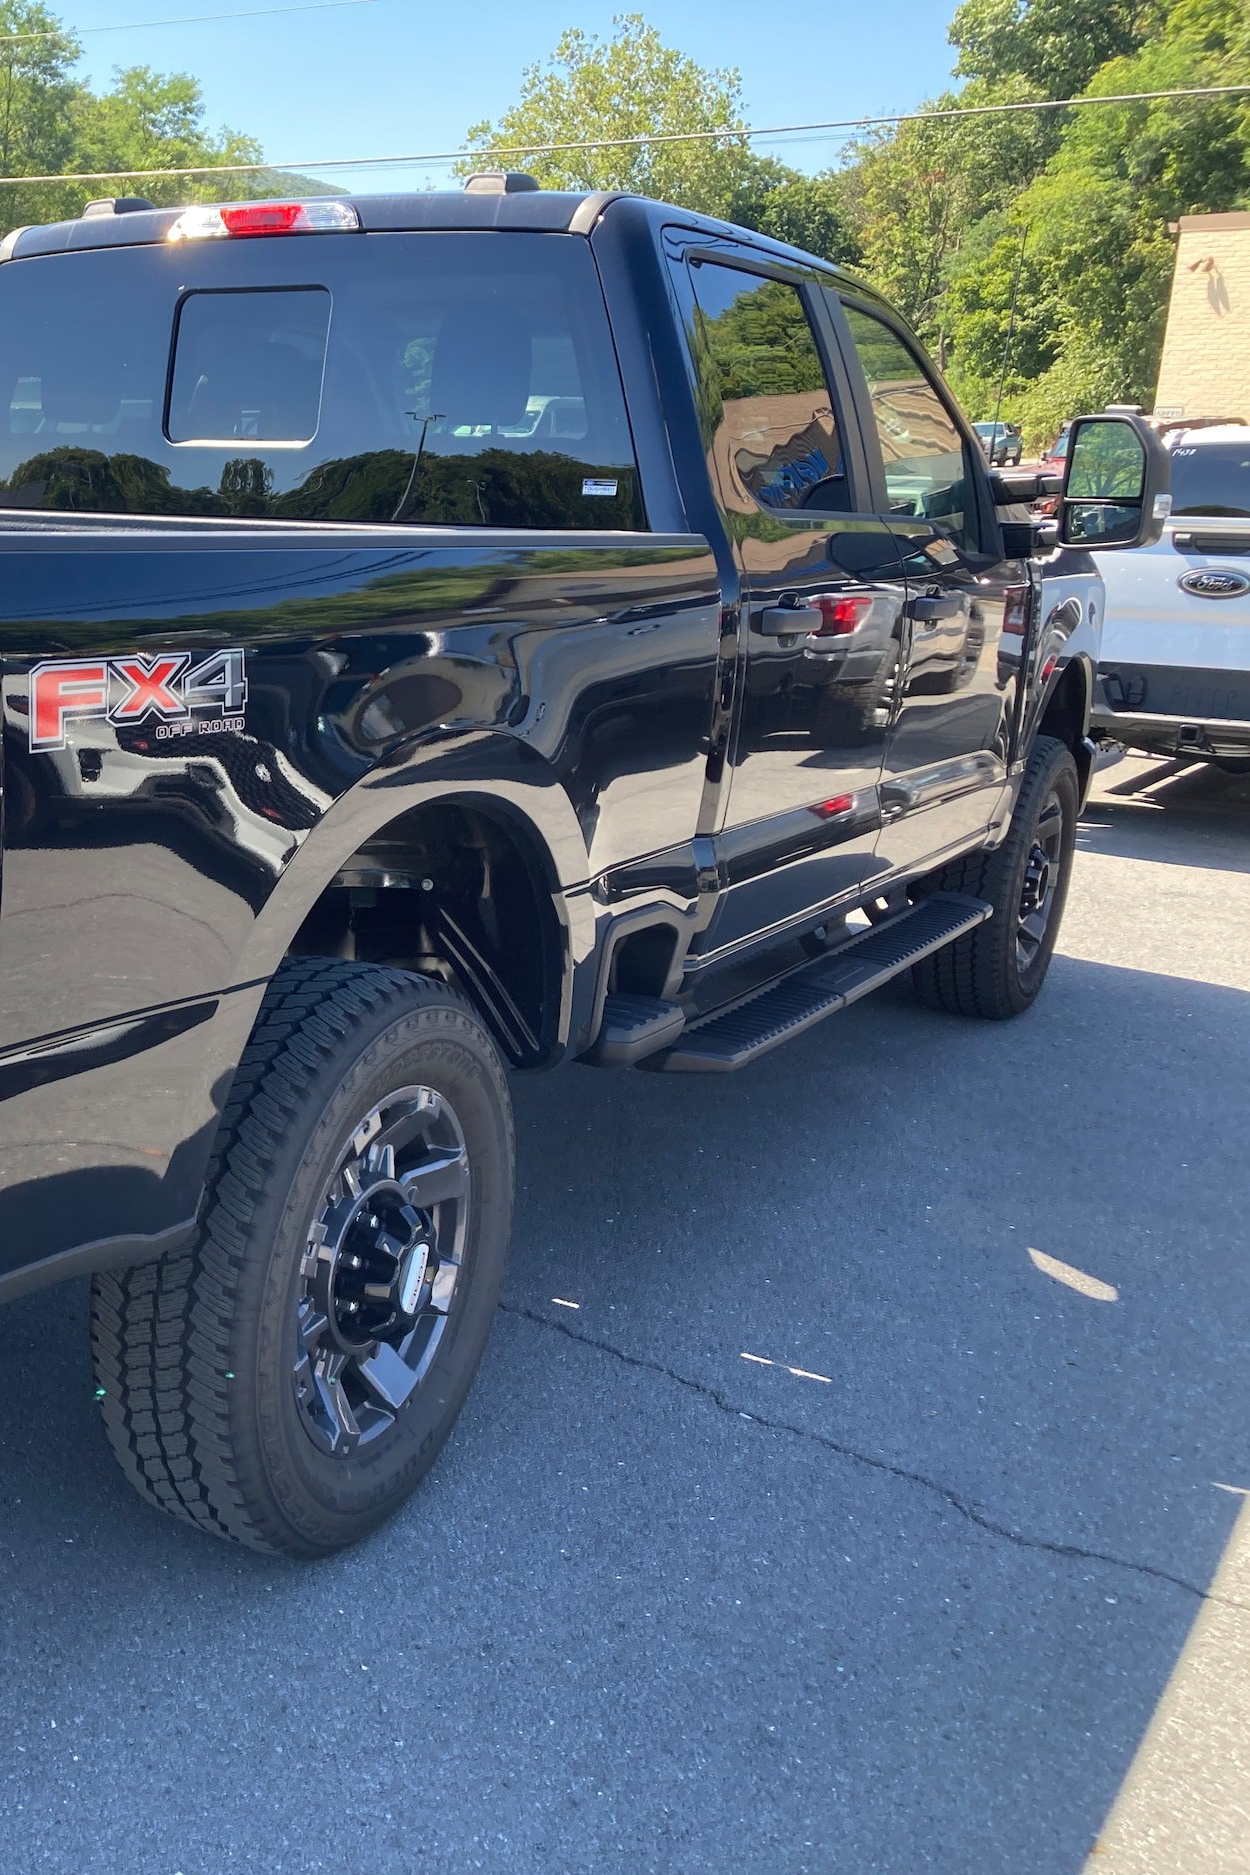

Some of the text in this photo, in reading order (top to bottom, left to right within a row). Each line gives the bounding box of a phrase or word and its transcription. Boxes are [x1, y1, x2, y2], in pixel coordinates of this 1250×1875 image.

[29, 648, 248, 754] FX4
[155, 716, 245, 740] OFF ROAD
